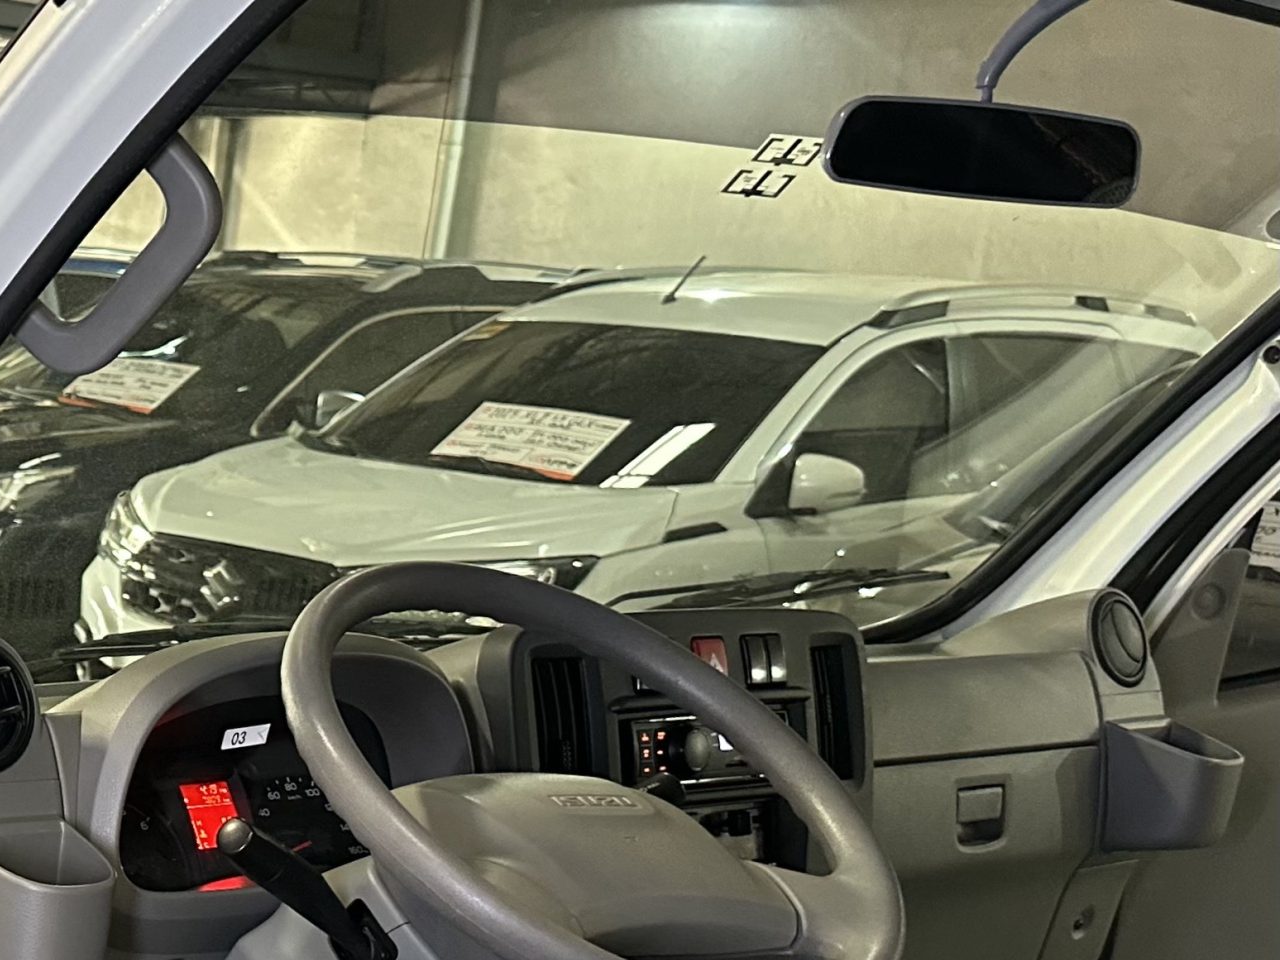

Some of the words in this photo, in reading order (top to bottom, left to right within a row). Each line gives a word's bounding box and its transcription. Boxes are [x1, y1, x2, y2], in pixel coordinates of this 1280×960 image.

[231, 731, 247, 746] 03
[284, 782, 297, 791] 80
[267, 791, 280, 800] 60
[305, 788, 320, 796] 100
[140, 820, 149, 831] 6
